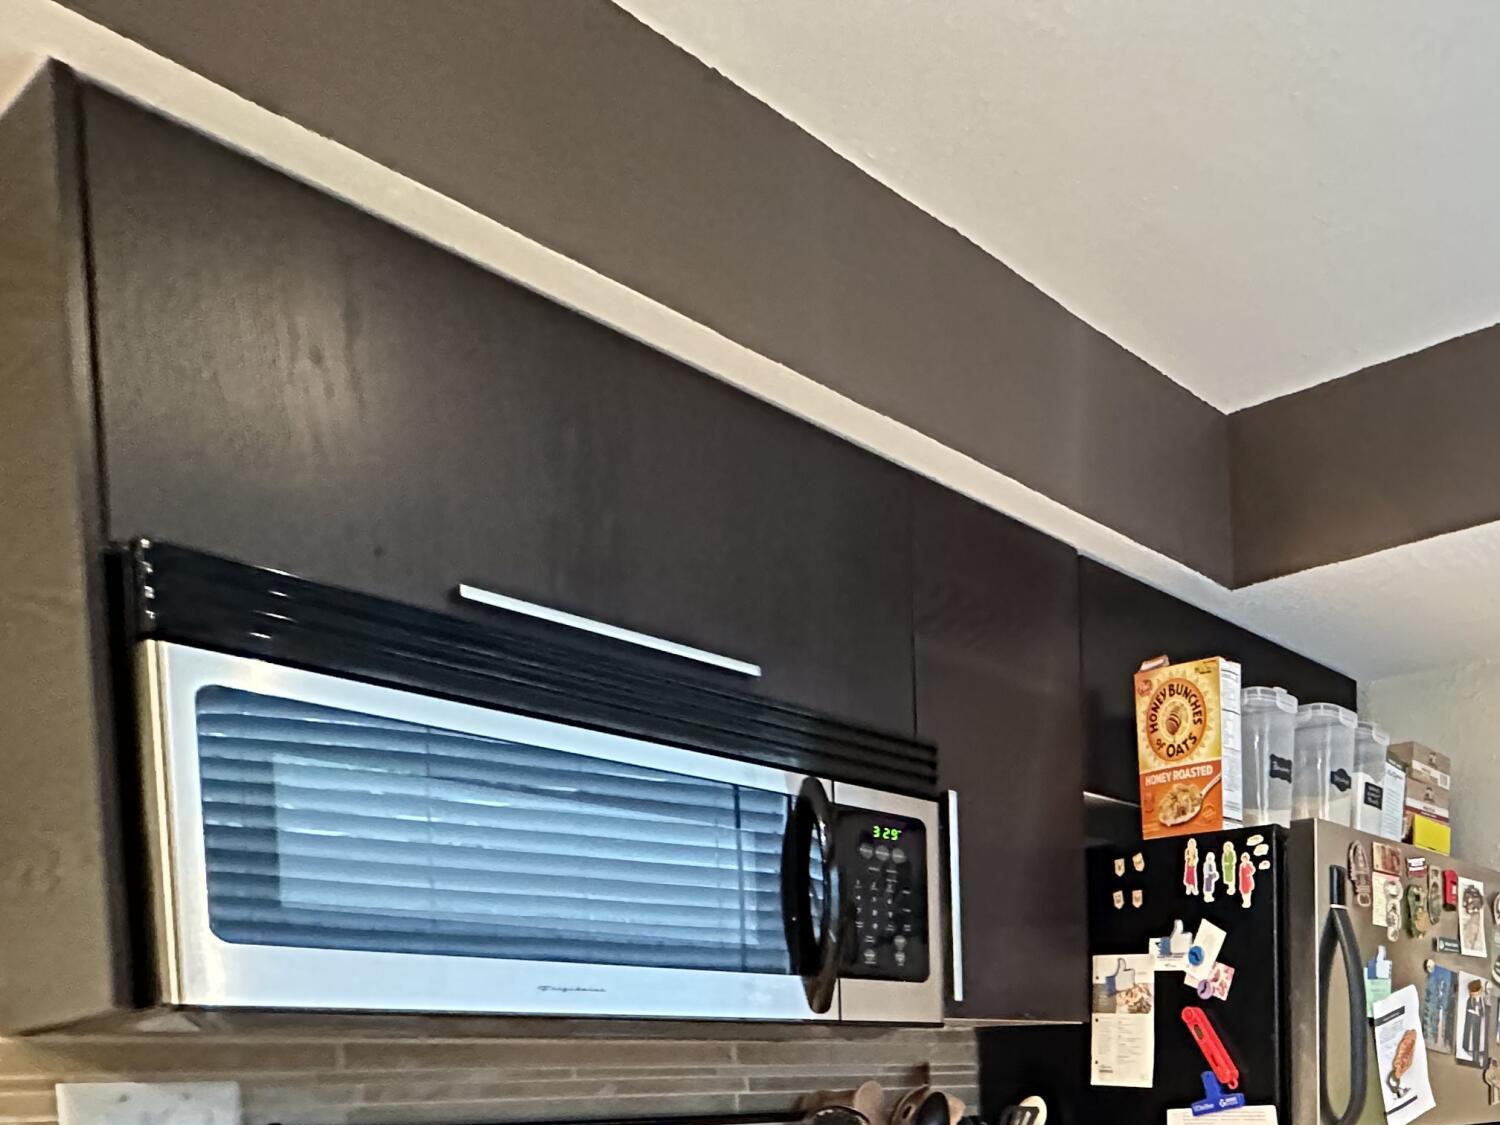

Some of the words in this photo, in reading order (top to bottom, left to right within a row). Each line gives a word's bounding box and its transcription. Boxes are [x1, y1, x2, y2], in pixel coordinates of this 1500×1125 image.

[1149, 688, 1167, 733] HONEY
[1168, 683, 1203, 725] BUNCHES
[1166, 732, 1198, 758] OATS
[1145, 771, 1172, 786] HONEY
[1173, 764, 1214, 780] ROASTED
